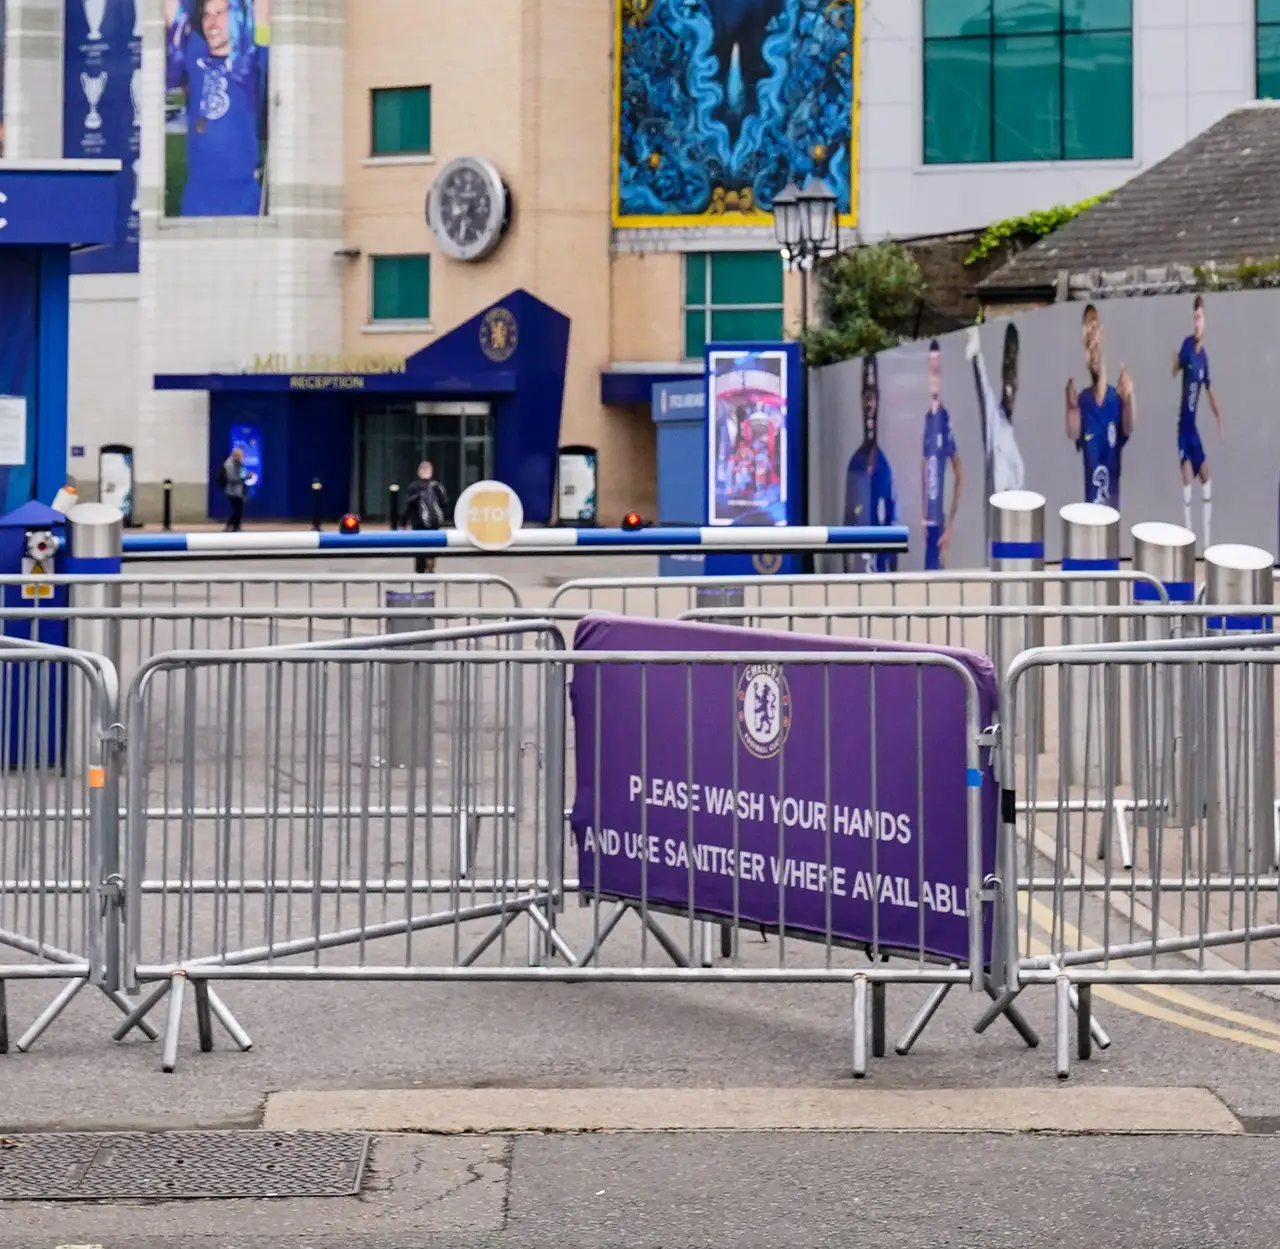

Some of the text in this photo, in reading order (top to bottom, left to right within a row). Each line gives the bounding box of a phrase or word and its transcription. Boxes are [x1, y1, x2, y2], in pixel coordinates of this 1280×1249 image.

[289, 375, 365, 389] RECEPTION
[704, 785, 764, 822] WASH
[769, 795, 827, 832] YOUR
[833, 804, 912, 845] HANDS
[584, 825, 969, 917] AND USE SANITISER WHERE AVAILABL
